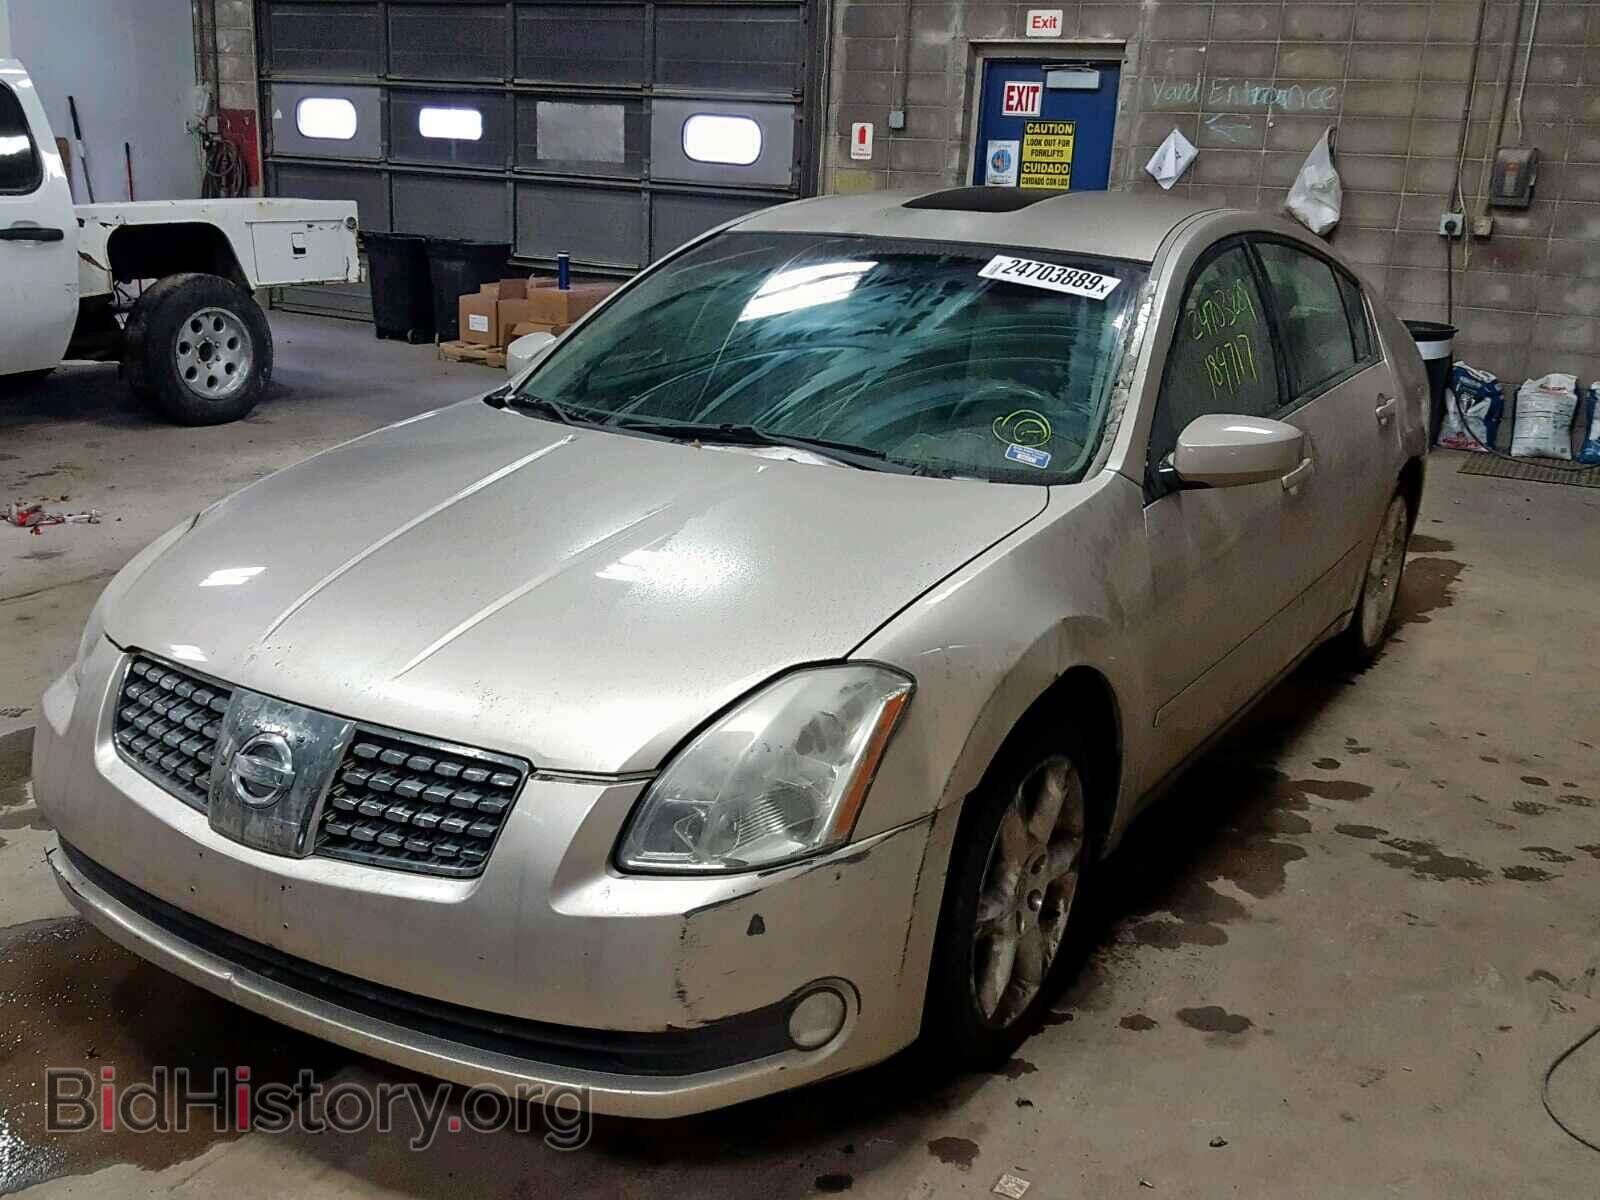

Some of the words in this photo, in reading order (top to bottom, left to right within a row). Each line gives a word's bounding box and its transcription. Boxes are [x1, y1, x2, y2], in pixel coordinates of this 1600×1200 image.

[1032, 16, 1057, 29] Exit
[1152, 72, 1200, 105] Yard
[1209, 79, 1337, 110] Entrance
[1005, 85, 1040, 112] EXIT
[1026, 123, 1073, 134] CAUTION
[1026, 138, 1043, 147] LOOK
[1044, 138, 1056, 147] OUT
[1058, 139, 1071, 147] FOR
[1030, 149, 1064, 158] FORKLIFTS
[1023, 163, 1069, 174] CUIDADO
[1022, 176, 1044, 186] CUIDADO
[1046, 177, 1057, 186] CON
[1058, 178, 1068, 187] LOS
